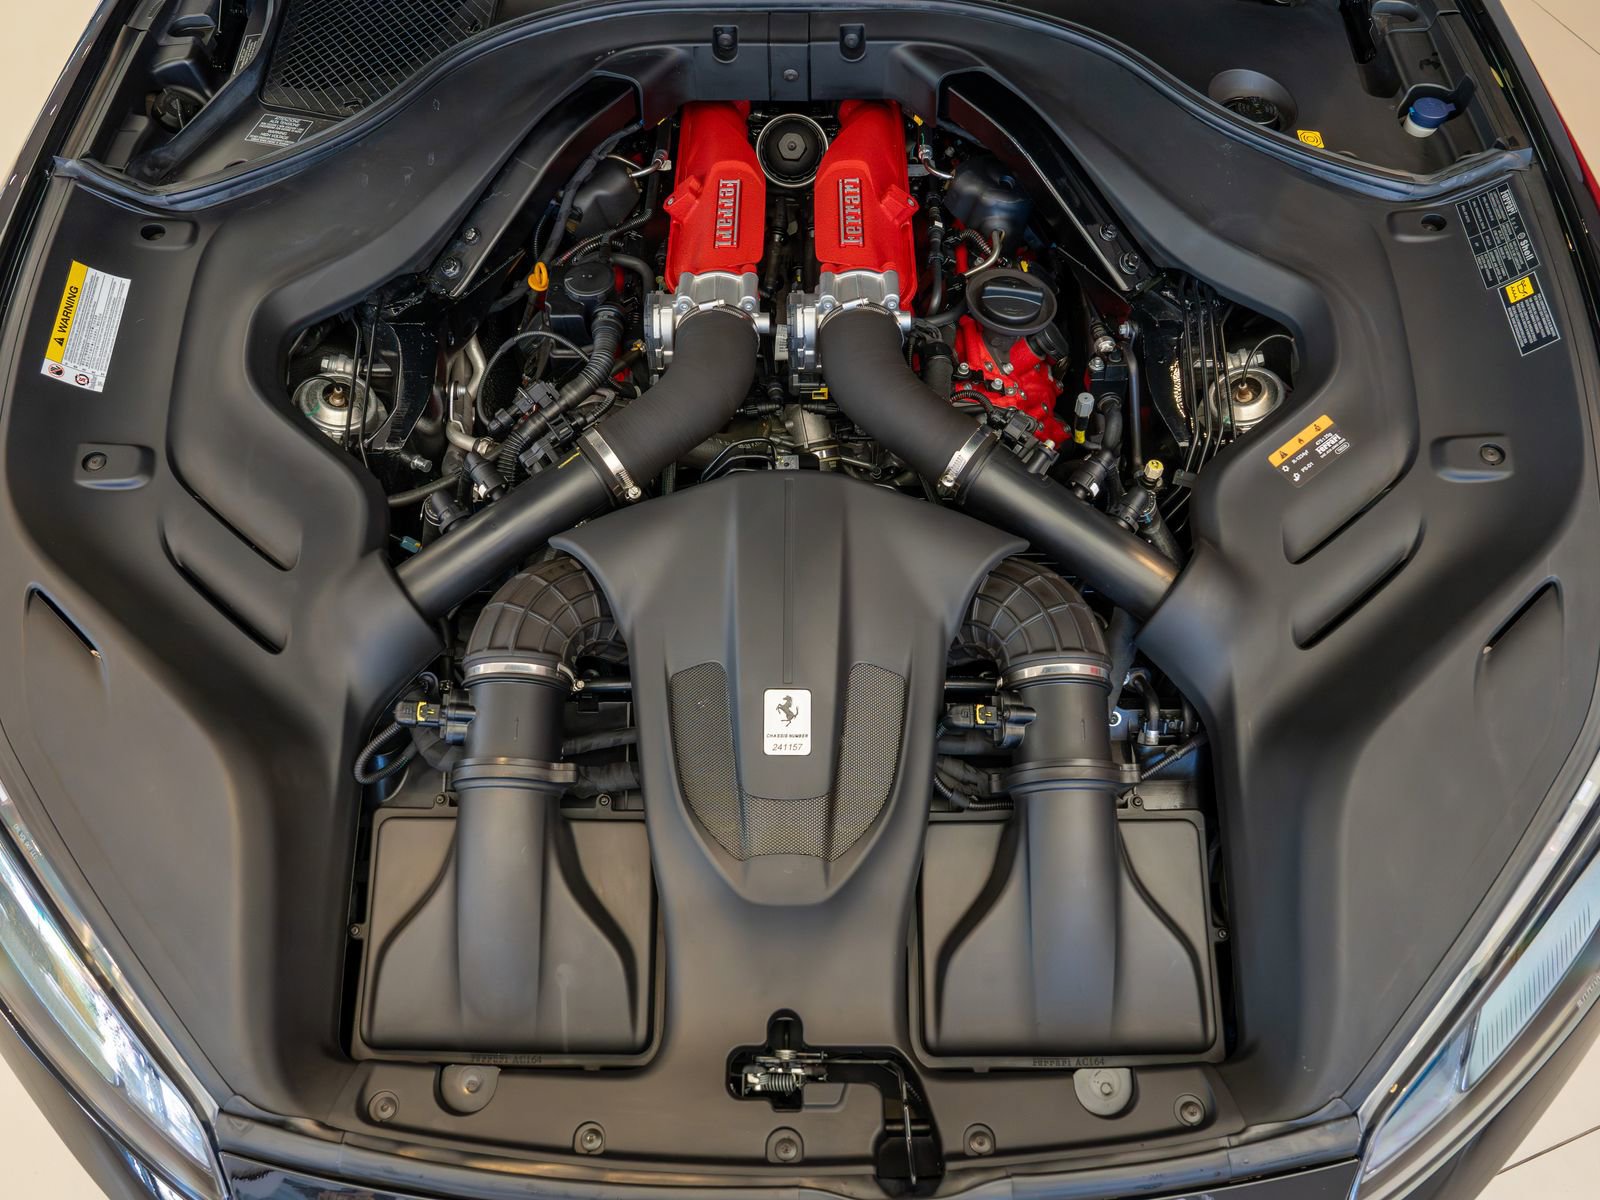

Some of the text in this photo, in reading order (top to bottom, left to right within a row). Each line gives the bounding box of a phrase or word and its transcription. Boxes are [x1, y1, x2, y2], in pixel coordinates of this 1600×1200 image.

[715, 178, 741, 249] Ferrari
[838, 176, 864, 248] Ferrari
[1501, 189, 1518, 216] Ferrari
[1520, 240, 1534, 261] Shell
[58, 285, 79, 334] WARNING
[1315, 433, 1341, 454] Ferrari
[772, 743, 803, 751] 241157
